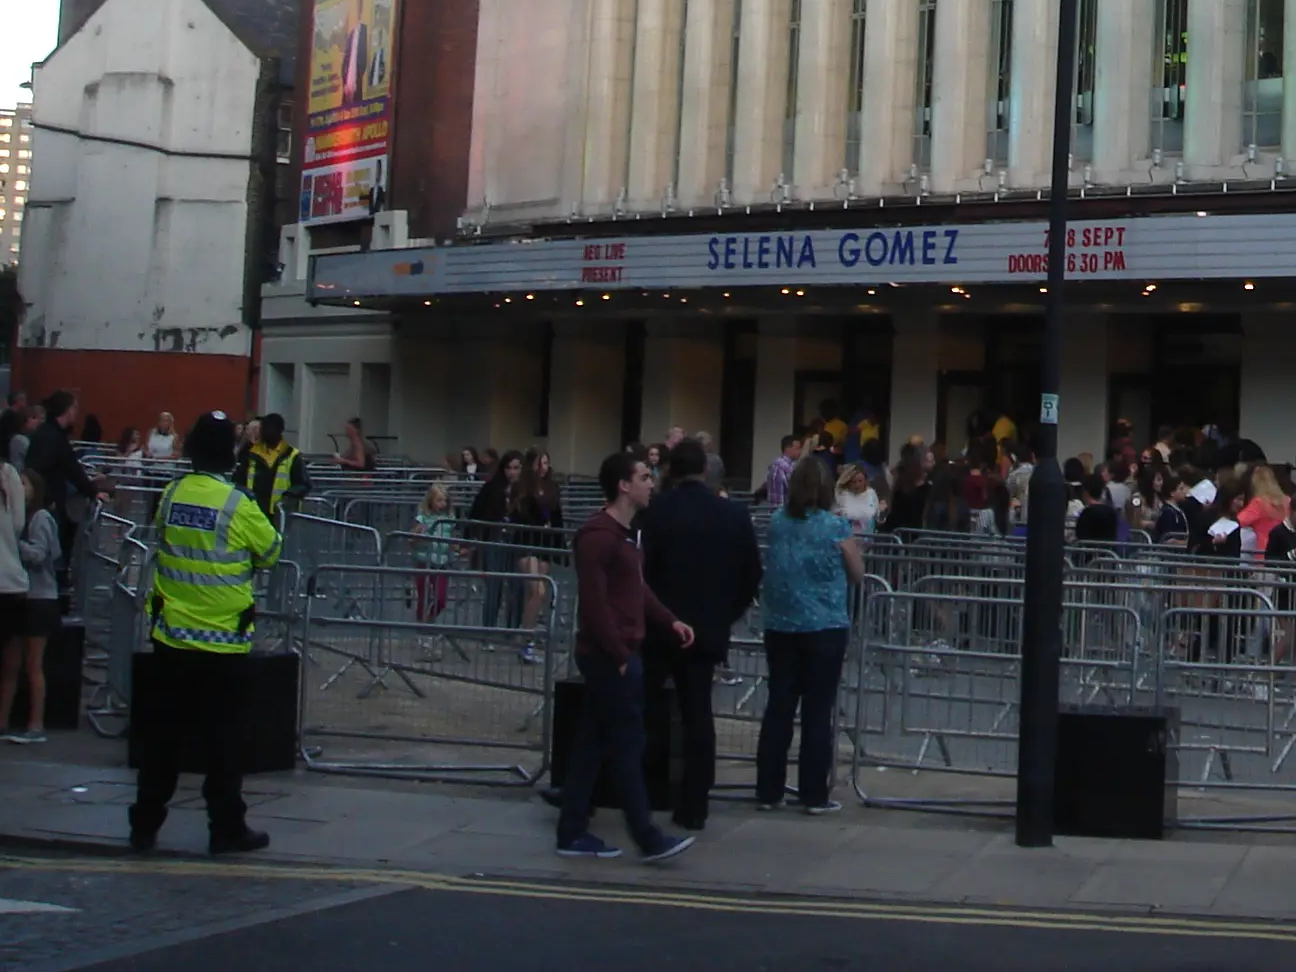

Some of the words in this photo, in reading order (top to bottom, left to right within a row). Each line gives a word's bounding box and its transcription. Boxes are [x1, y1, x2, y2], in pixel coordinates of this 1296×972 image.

[1066, 228, 1076, 248] 8
[1082, 227, 1126, 247] SEPT
[605, 243, 626, 260] LIVE
[707, 235, 816, 270] SELENA
[838, 229, 959, 268] GOMEZ
[1008, 253, 1049, 273] DOORS
[1104, 251, 1126, 271] PM
[582, 266, 623, 283] PRESENT
[171, 511, 214, 528] POLICE
